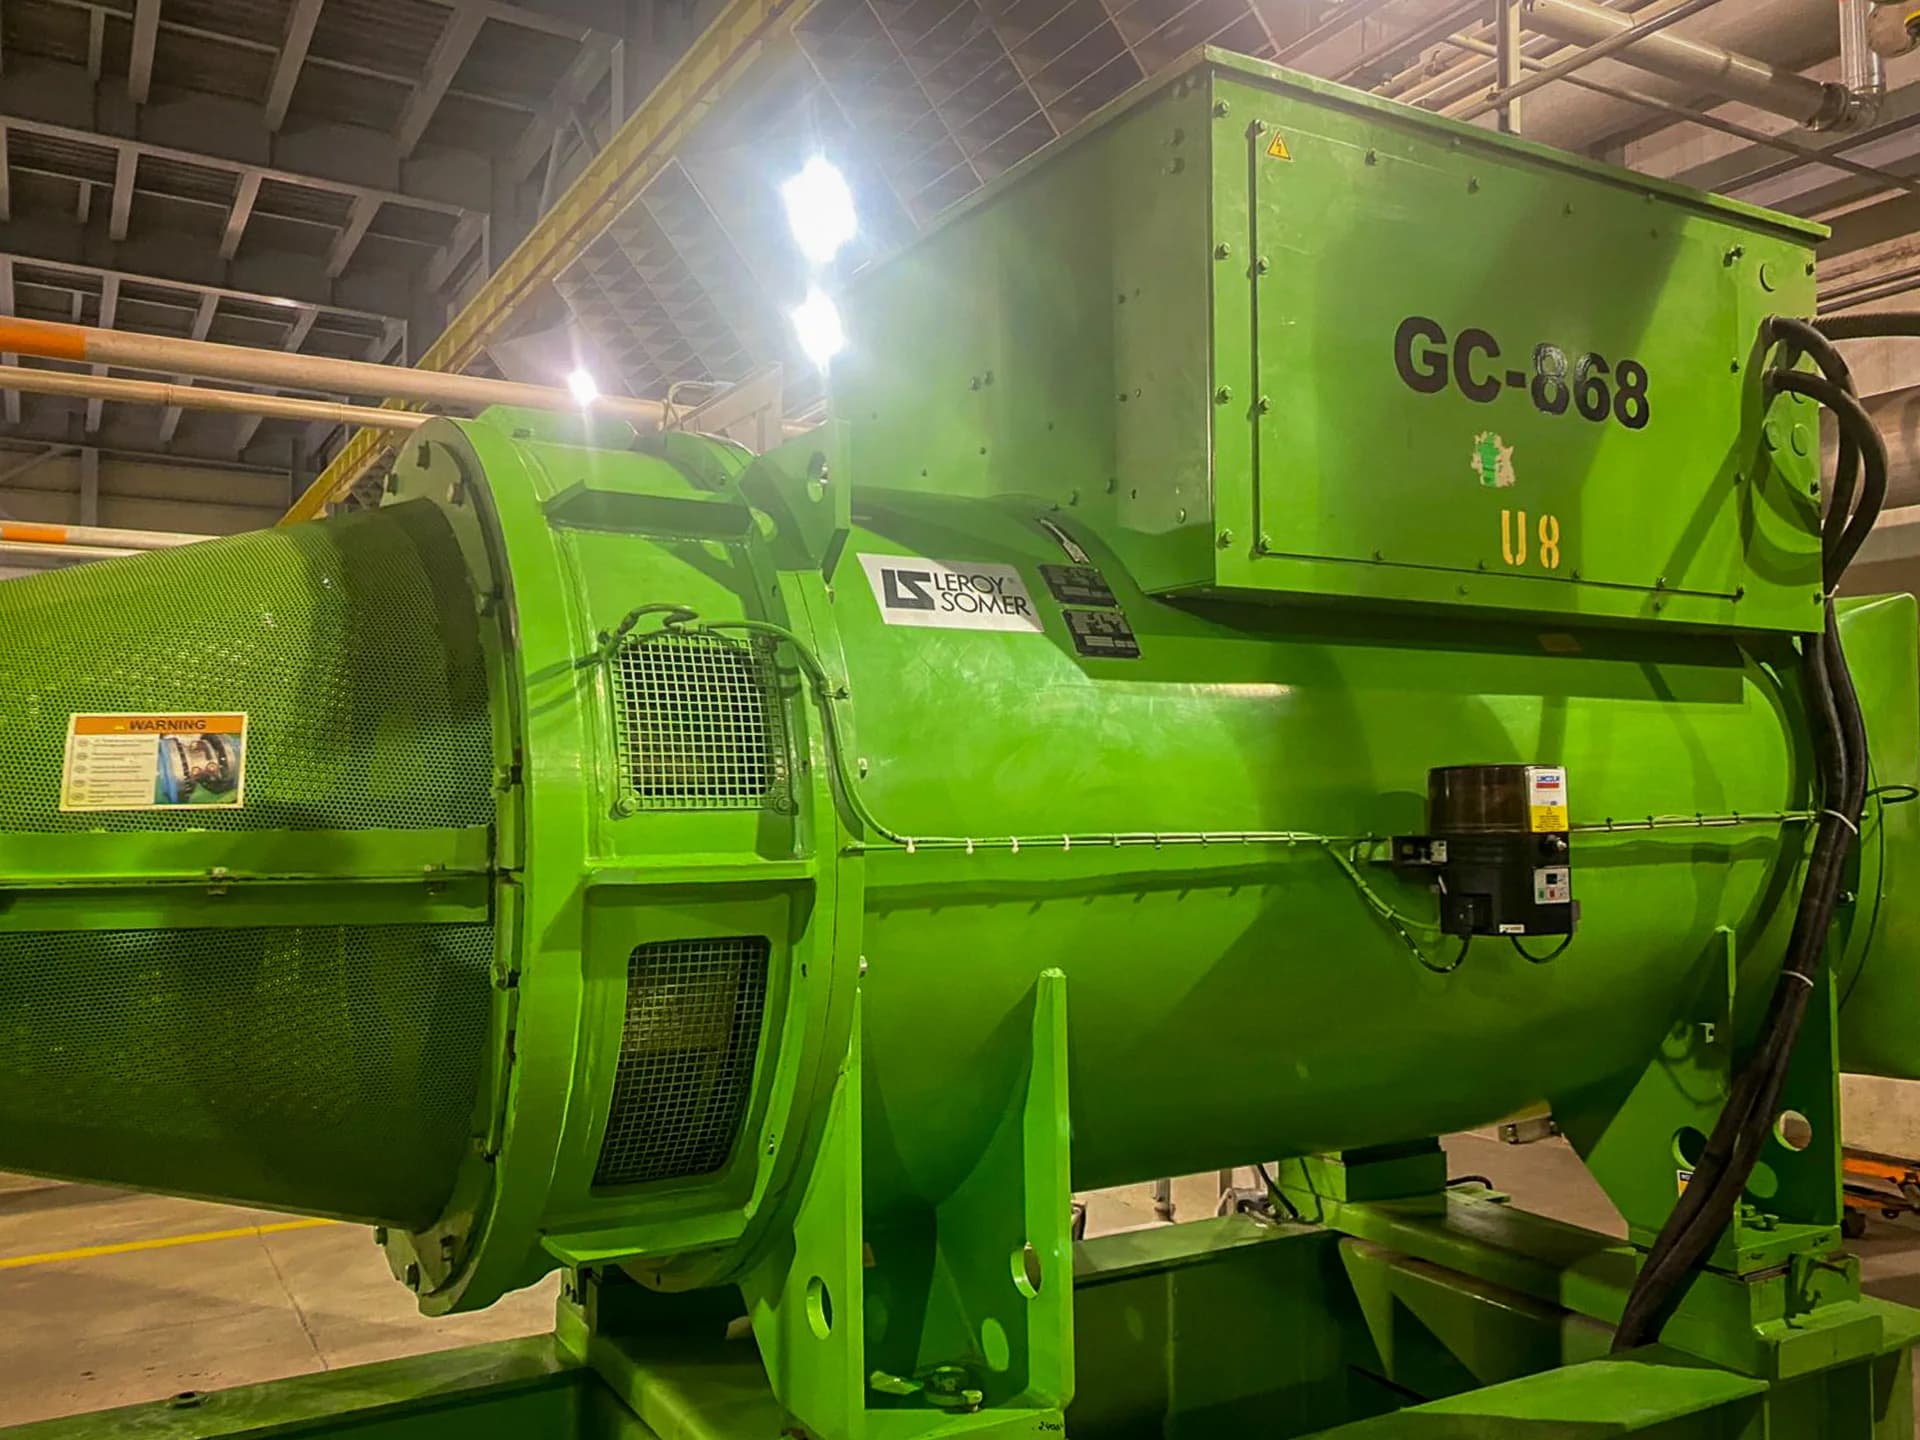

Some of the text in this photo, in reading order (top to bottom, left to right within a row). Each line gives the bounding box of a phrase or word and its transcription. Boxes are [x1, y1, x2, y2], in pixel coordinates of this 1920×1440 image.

[1394, 316, 1651, 430] GC-868
[933, 572, 1004, 594] LEROY
[940, 592, 1031, 616] SOMER
[129, 719, 206, 731] WARNING
